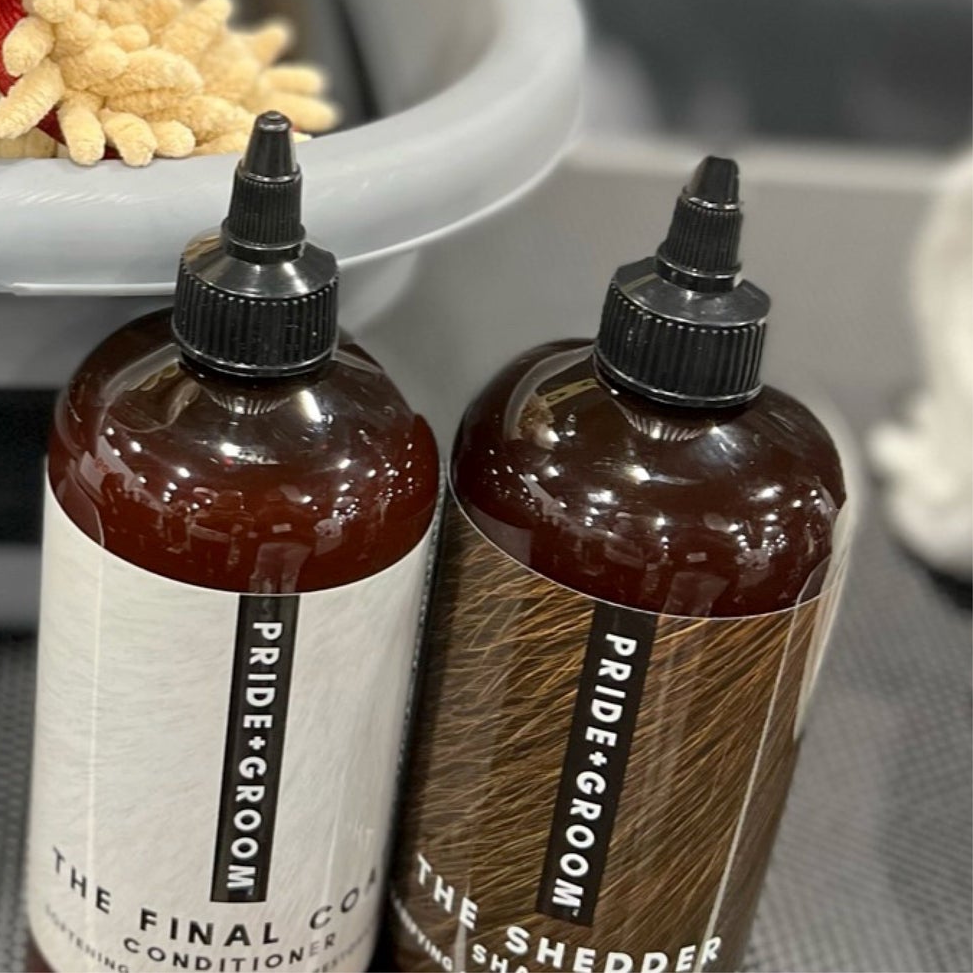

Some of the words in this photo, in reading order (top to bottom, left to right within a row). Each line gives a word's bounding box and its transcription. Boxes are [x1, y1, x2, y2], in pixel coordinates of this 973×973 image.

[53, 845, 111, 915] THE
[139, 907, 279, 947] FINAL
[416, 852, 478, 930] THE
[505, 926, 722, 973] SHEDDER
[123, 932, 336, 973] CONDITIONER
